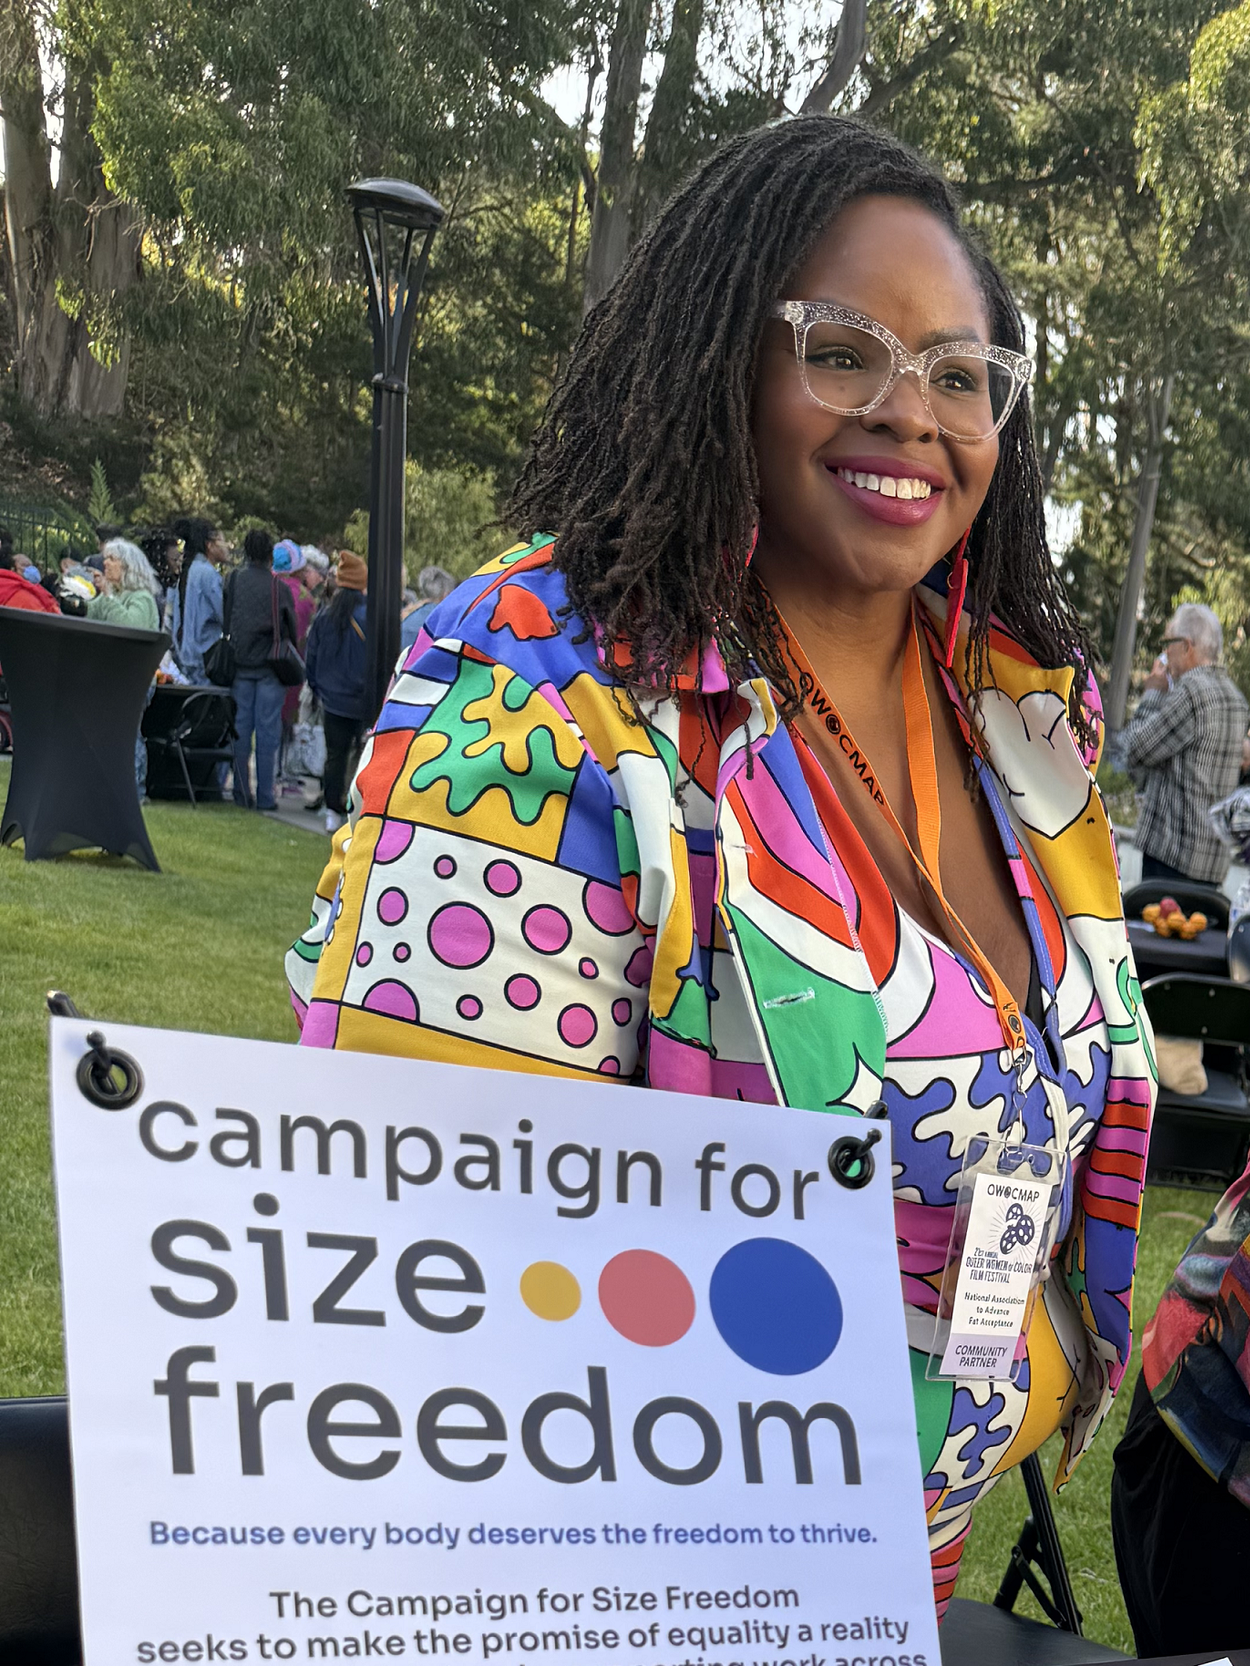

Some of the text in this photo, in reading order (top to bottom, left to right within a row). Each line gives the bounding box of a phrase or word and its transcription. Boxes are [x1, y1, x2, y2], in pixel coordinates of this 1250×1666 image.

[138, 1098, 820, 1221] campaign for
[148, 1193, 487, 1334] size
[984, 1271, 1010, 1284] FESTIVAL
[964, 1292, 1025, 1305] National Association
[976, 1306, 1010, 1315] to Advance
[968, 1317, 1014, 1328] Fat Acceptance
[955, 1344, 1008, 1358] COMMUNITY
[959, 1356, 997, 1369] PARTNER
[152, 1345, 863, 1487] freedom
[150, 1521, 878, 1550] Because every body deserves the freedom to thrive.
[269, 1585, 799, 1621] The Campaign for Size Freedom
[137, 1616, 909, 1664] seeks to make the promise of equality a reality
